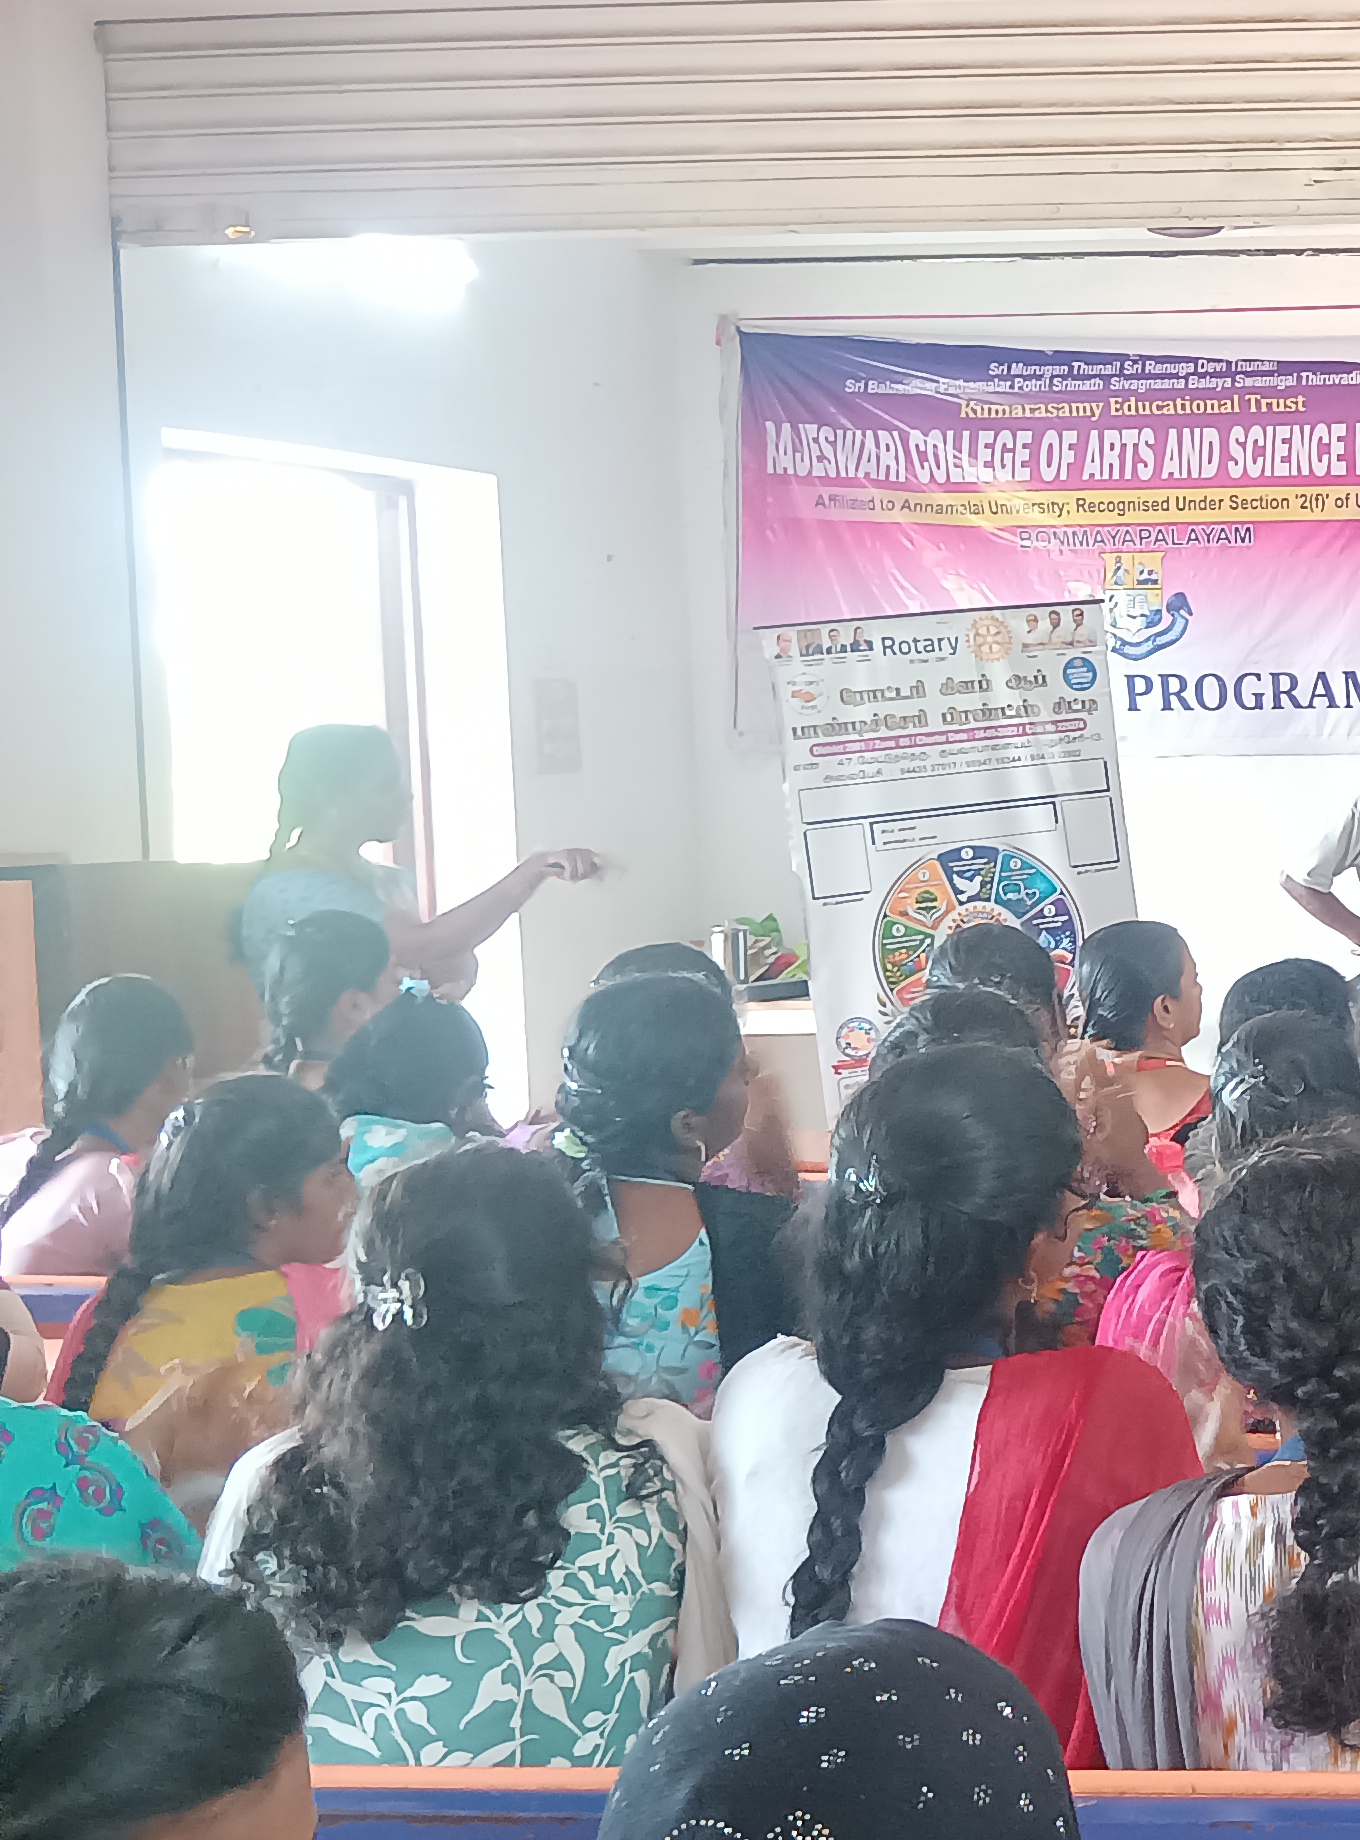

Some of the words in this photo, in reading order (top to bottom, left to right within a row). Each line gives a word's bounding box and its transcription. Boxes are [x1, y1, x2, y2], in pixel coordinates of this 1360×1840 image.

[1010, 362, 1068, 378] Murugan
[1145, 361, 1195, 376] Renuga
[960, 399, 1105, 421] Kumarasamy
[1109, 394, 1241, 416] Educational
[1245, 393, 1307, 413] Trust
[765, 420, 907, 483] RAJESWARI
[909, 428, 1034, 485] COLLEGE
[1039, 428, 1079, 482] OF
[1081, 427, 1155, 482] ARTS
[1161, 427, 1221, 480] AND
[1227, 422, 1348, 480] SCIENCE
[879, 497, 896, 512] to
[899, 497, 985, 516] Annamalai
[1075, 495, 1170, 517] Recognised
[1175, 495, 1224, 513] Under
[1229, 494, 1291, 512] Section
[1335, 492, 1350, 509] of
[1017, 525, 1254, 549] BOMMAYAPALAYAM
[881, 631, 960, 657] Rotary
